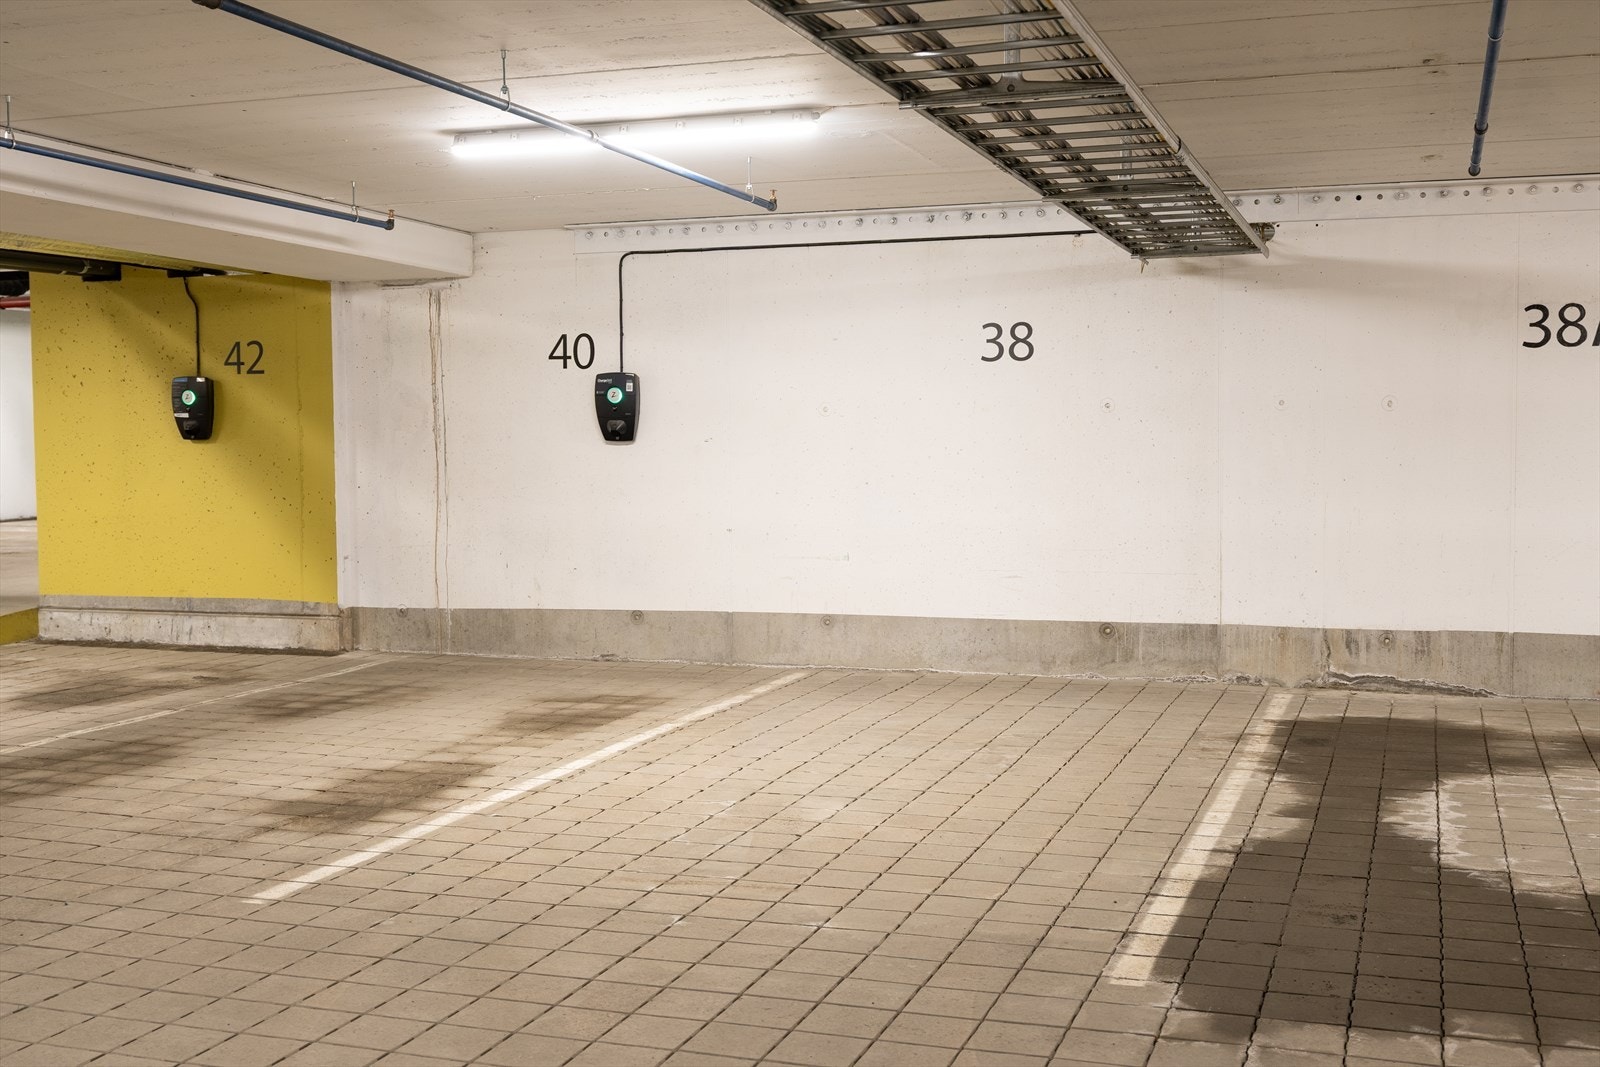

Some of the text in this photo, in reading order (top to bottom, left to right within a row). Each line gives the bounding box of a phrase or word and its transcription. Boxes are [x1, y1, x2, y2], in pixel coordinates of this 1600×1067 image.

[224, 340, 265, 375] 42
[548, 332, 595, 370] 40
[981, 322, 1034, 362] 38
